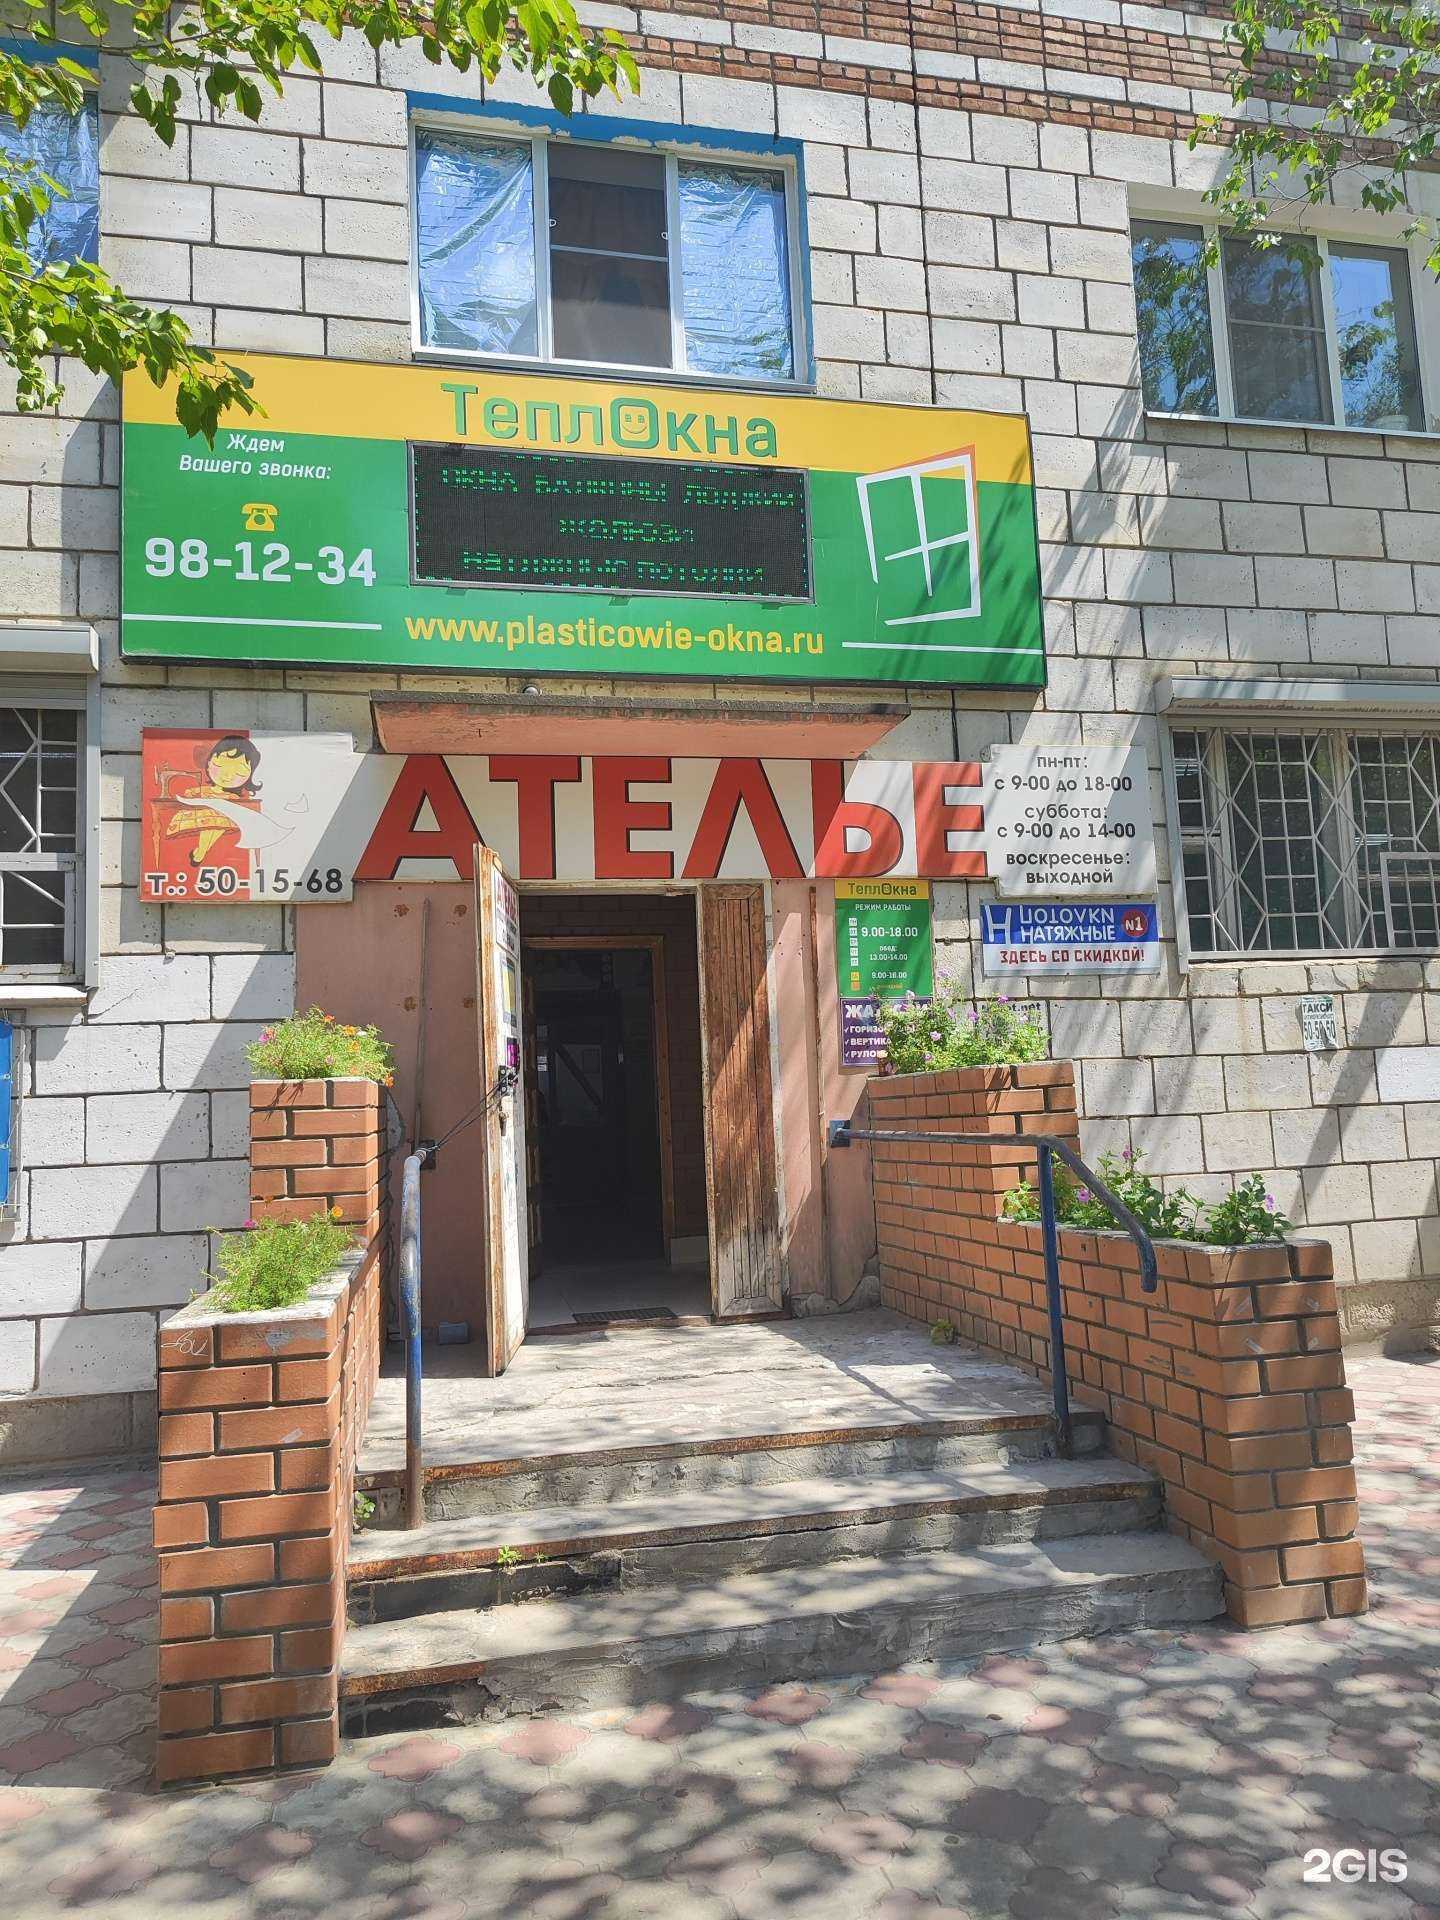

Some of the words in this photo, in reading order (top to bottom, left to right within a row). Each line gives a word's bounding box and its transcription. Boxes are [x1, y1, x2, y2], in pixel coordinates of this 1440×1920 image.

[226, 433, 285, 454] Ждем
[179, 454, 253, 477] Вашего
[258, 461, 332, 481] звонка:
[145, 537, 377, 587] 98-12-34
[405, 616, 824, 654] www.plasticowie-okna.ru
[1011, 775, 1050, 791] 9-00
[1056, 780, 1077, 792] до
[1084, 776, 1132, 791] 18-00
[353, 753, 988, 881] АТЕЛЬЕ
[1024, 804, 1108, 821] суббота:
[1014, 822, 1053, 838] 9-00
[1059, 827, 1080, 840] до
[1088, 823, 1136, 838] 14-00
[1006, 852, 1130, 869] воскресенье:
[197, 868, 344, 896] 50-15-68
[855, 903, 881, 911] РЕЖИМ
[861, 926, 918, 937] 9.00-18.00
[1020, 925, 1116, 945] НАТЯЖНЫЕ
[1000, 950, 1047, 964] ЗДЕСЬ
[1052, 949, 1070, 962] СО
[1075, 946, 1145, 963] СКИДКОЙ!
[1302, 1002, 1333, 1013] ТАКСИ
